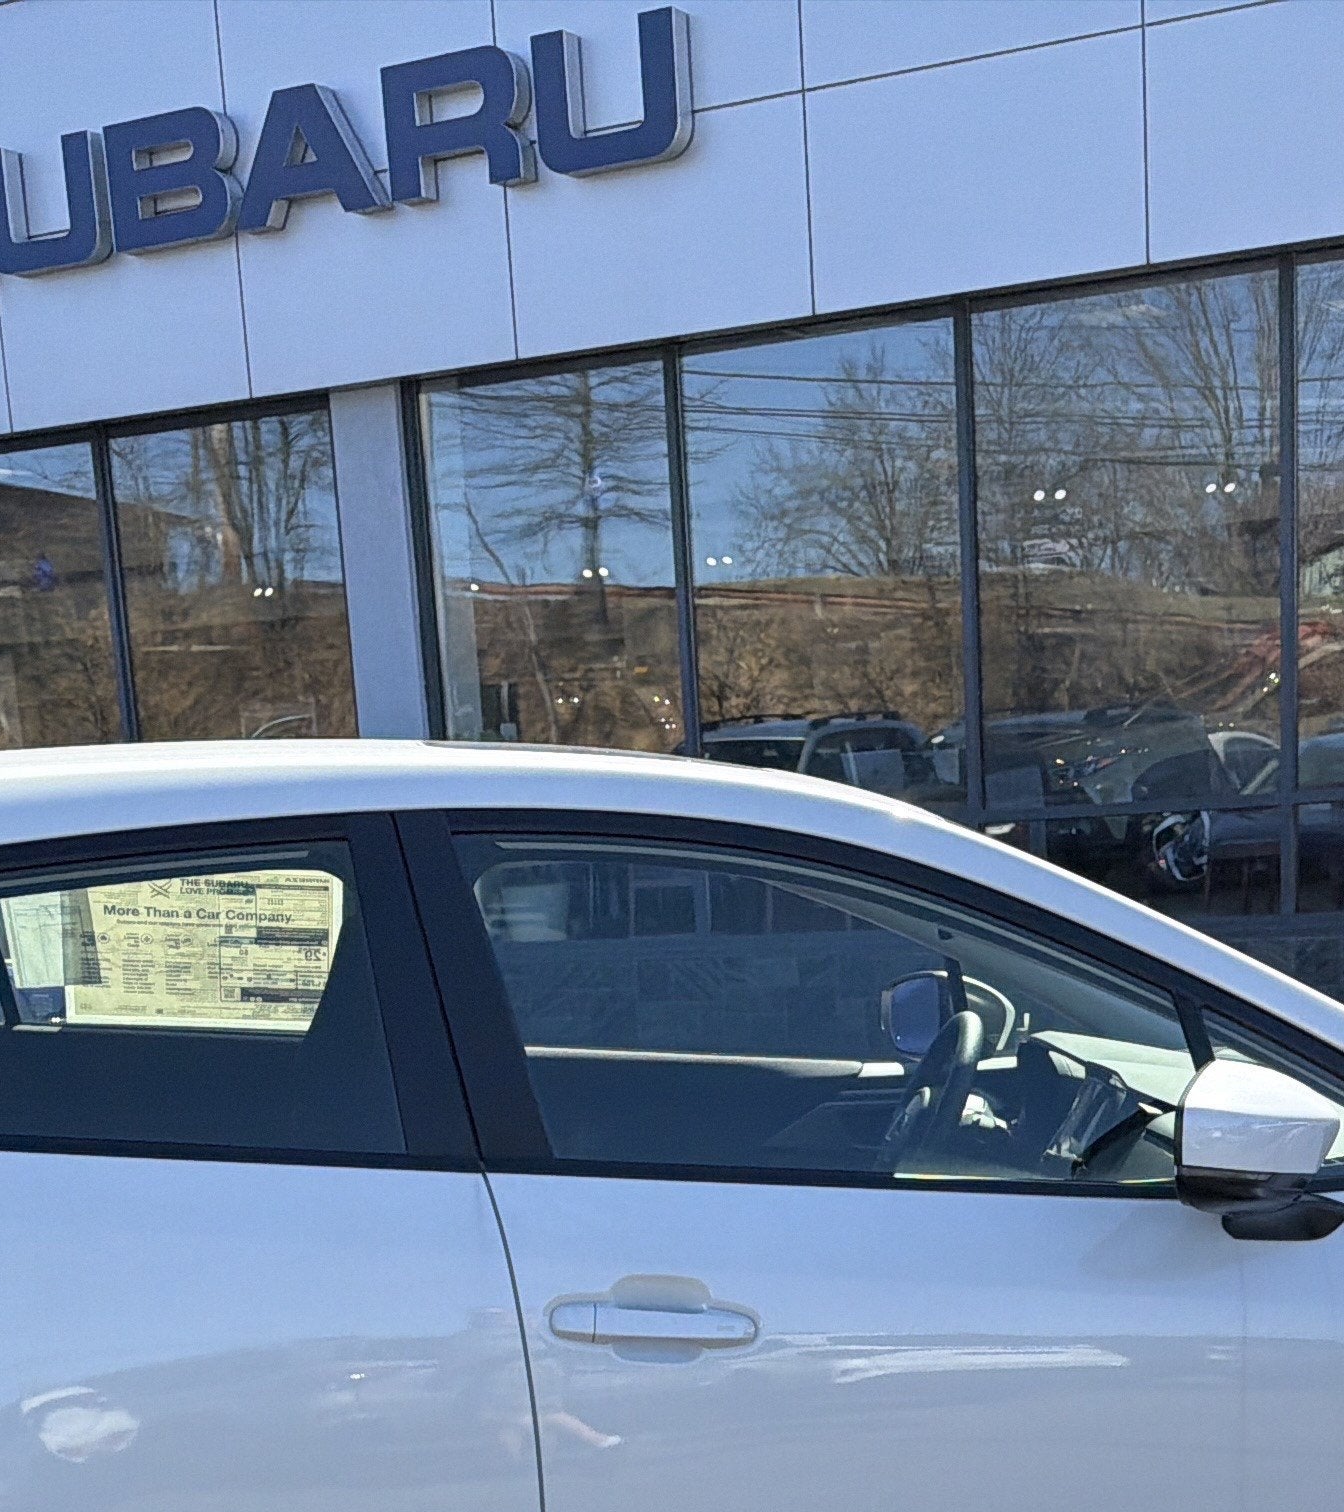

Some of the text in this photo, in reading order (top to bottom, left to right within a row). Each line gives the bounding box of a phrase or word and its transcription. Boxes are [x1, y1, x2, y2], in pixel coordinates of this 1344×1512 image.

[179, 878, 201, 887] THE
[179, 887, 204, 895] LOVE
[103, 904, 140, 917] More
[143, 906, 179, 919] Than
[183, 909, 192, 919] a
[196, 908, 221, 920] Car
